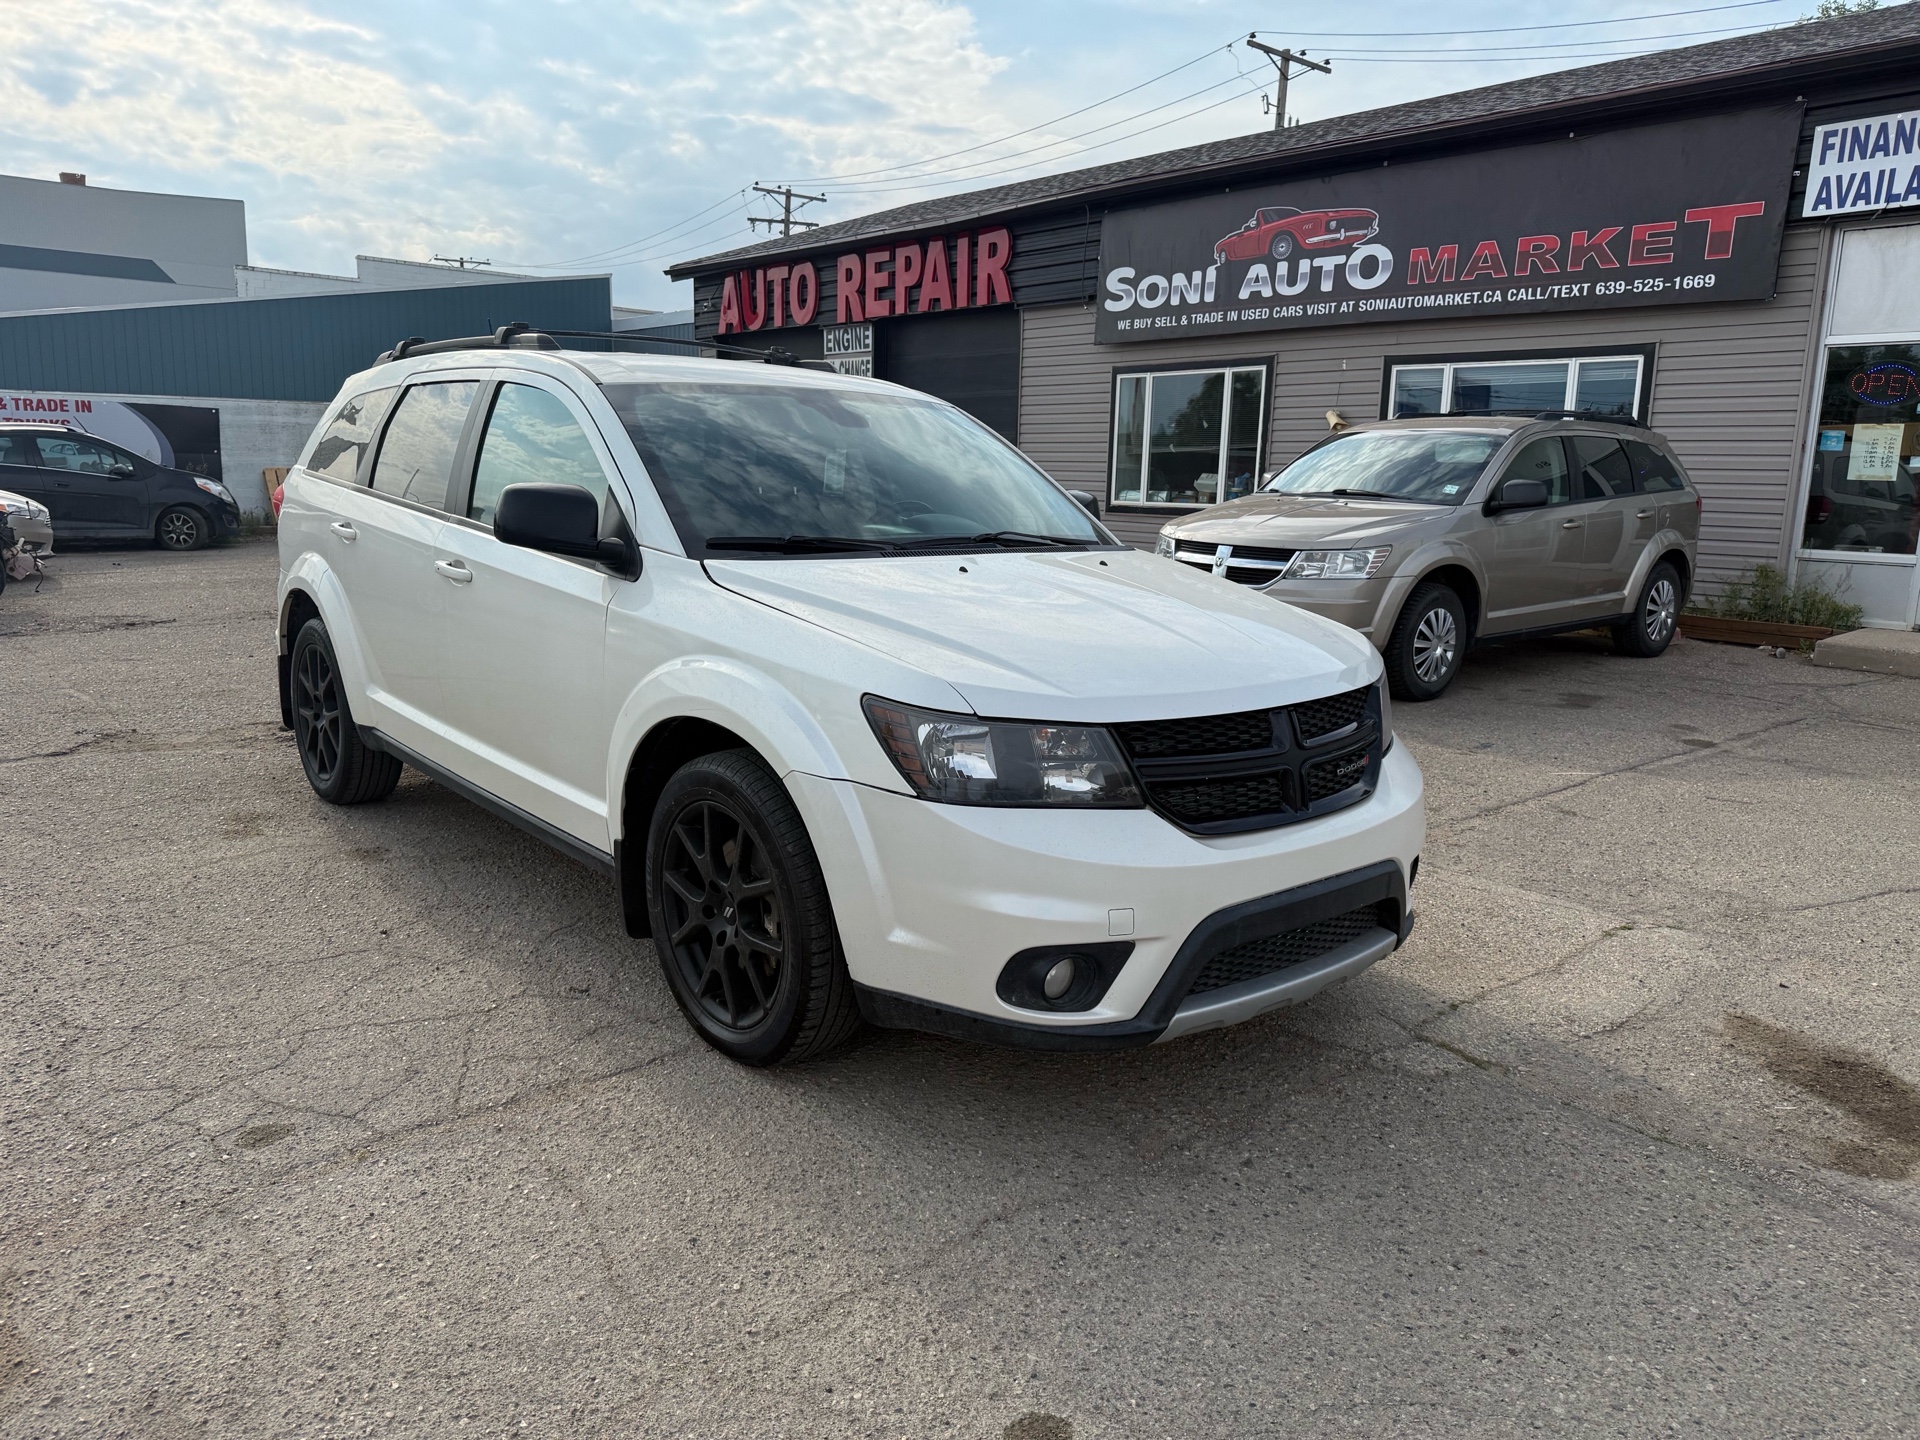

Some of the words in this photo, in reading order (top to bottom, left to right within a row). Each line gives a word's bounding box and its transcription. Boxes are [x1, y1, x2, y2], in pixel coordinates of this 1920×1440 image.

[1819, 117, 1920, 166] FINAN
[1238, 244, 1394, 300] AUTO
[1407, 201, 1765, 285] MARKET
[718, 260, 819, 335] AUTO
[837, 225, 1016, 324] REPAIR
[1117, 319, 1131, 331] WE
[1134, 318, 1153, 330] BUY
[1155, 316, 1178, 328] SELL
[1180, 315, 1188, 326] &
[1191, 311, 1224, 325] TRADE
[1227, 310, 1238, 322] IN
[1241, 308, 1270, 320] USED
[1273, 305, 1303, 318] CARS
[1306, 302, 1338, 316] VISIT
[1340, 301, 1356, 313] AT
[1358, 290, 1503, 312] SONIAUTOMARKET.CA
[1507, 283, 1591, 303] CALL/TEXT
[1595, 273, 1716, 296] 639-525-1669
[825, 326, 871, 353] ENGINE
[11, 397, 70, 413] TRADE
[75, 399, 93, 413] IN
